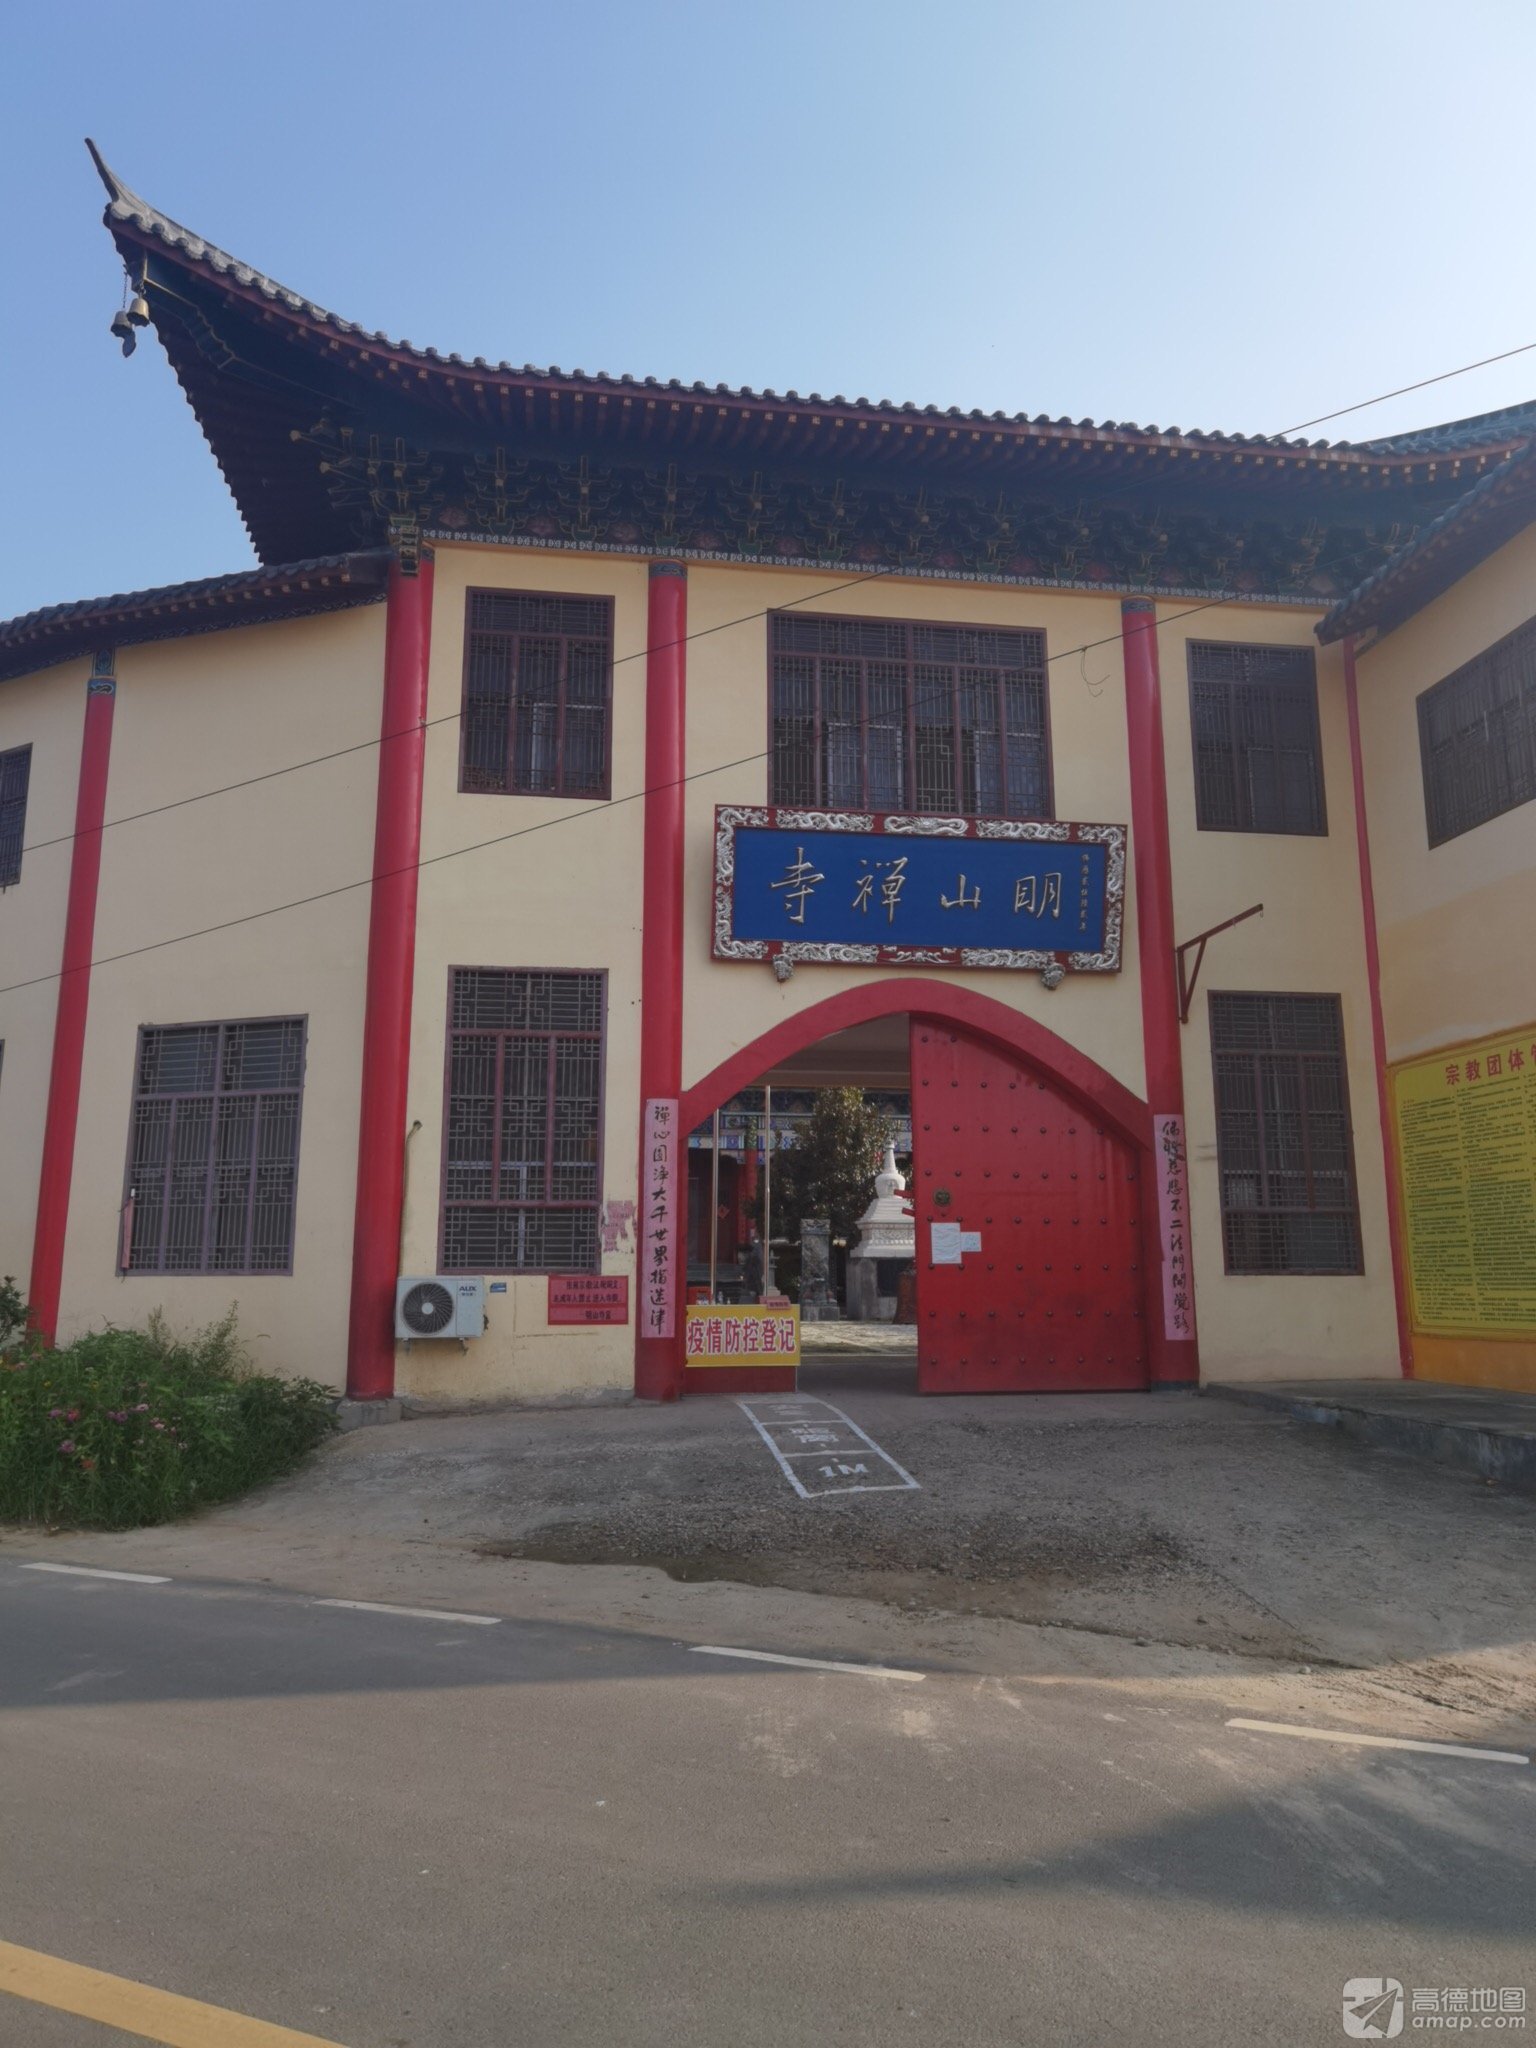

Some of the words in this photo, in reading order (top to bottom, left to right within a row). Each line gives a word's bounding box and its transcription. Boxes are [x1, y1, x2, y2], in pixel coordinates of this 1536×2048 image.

[687, 1319, 796, 1354] 疫情防控登记
[818, 1463, 870, 1478] 1M
